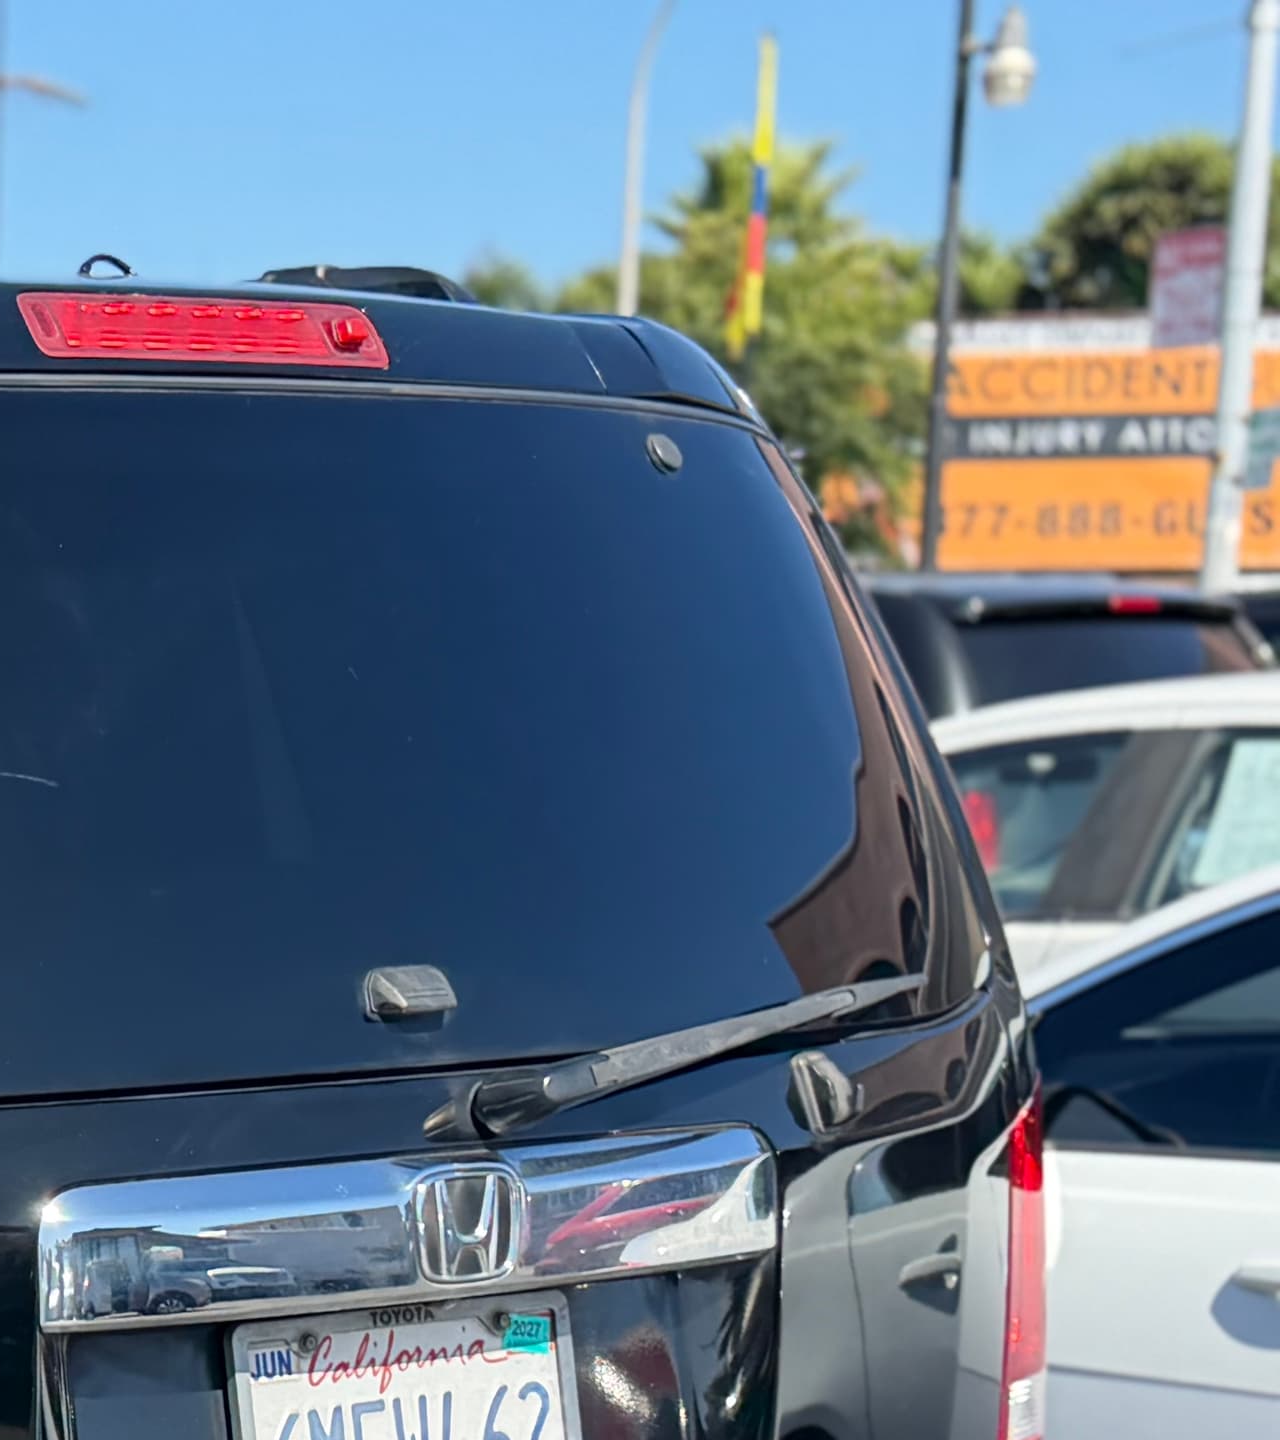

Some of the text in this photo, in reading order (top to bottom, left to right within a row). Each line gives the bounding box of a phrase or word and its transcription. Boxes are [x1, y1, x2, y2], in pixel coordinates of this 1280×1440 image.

[946, 357, 1209, 402] ACCIDENT
[967, 420, 1107, 455] INJURY
[370, 1304, 435, 1328] TOYOTA
[512, 1318, 542, 1340] 2027
[250, 1348, 293, 1379] JUN
[307, 1329, 509, 1395] California
